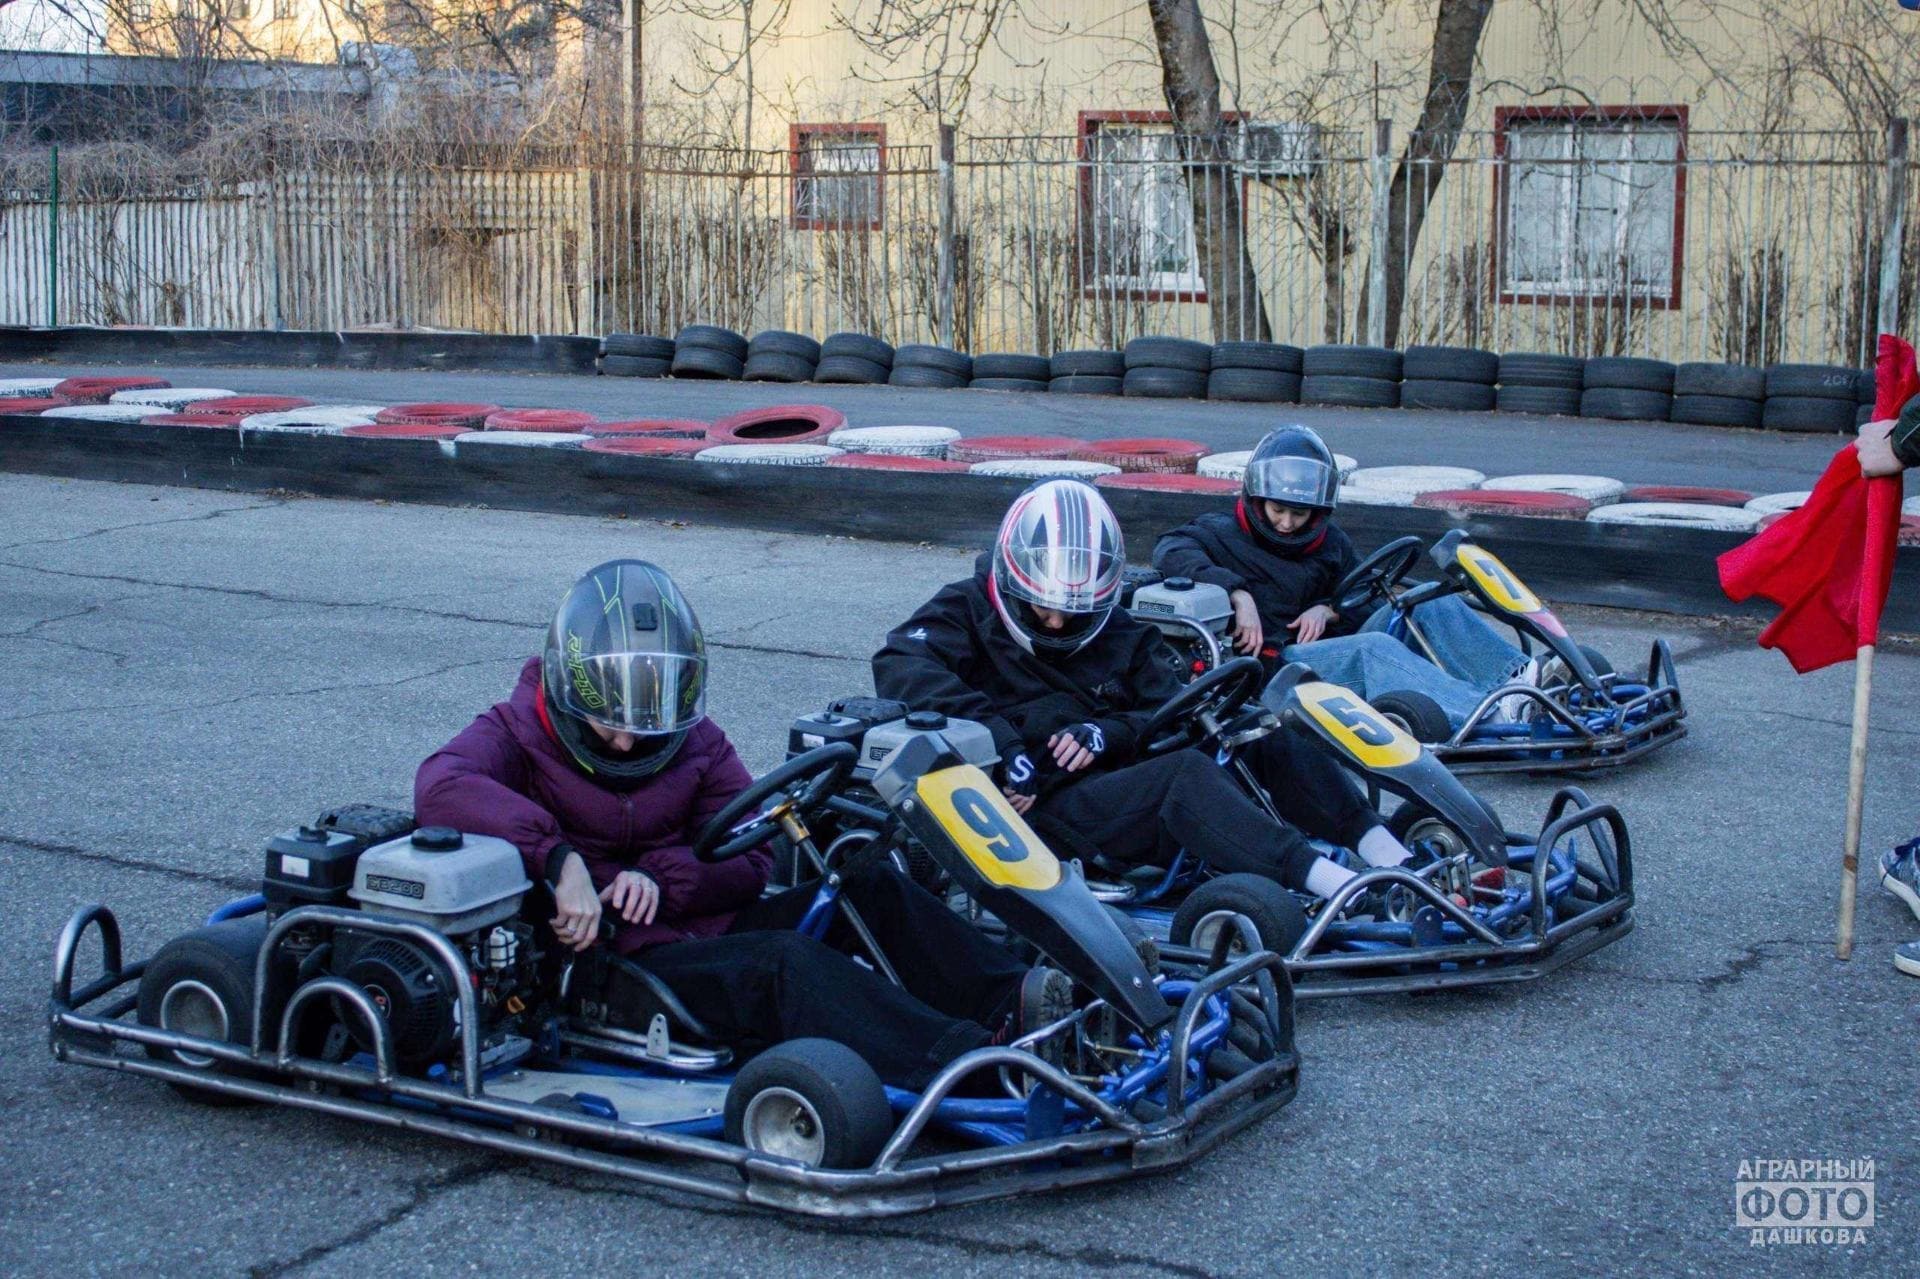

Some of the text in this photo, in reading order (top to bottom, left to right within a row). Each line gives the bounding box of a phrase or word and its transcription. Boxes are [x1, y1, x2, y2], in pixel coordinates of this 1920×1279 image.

[1316, 696, 1395, 746] 5
[1009, 754, 1035, 783] S
[950, 787, 1029, 863] 9
